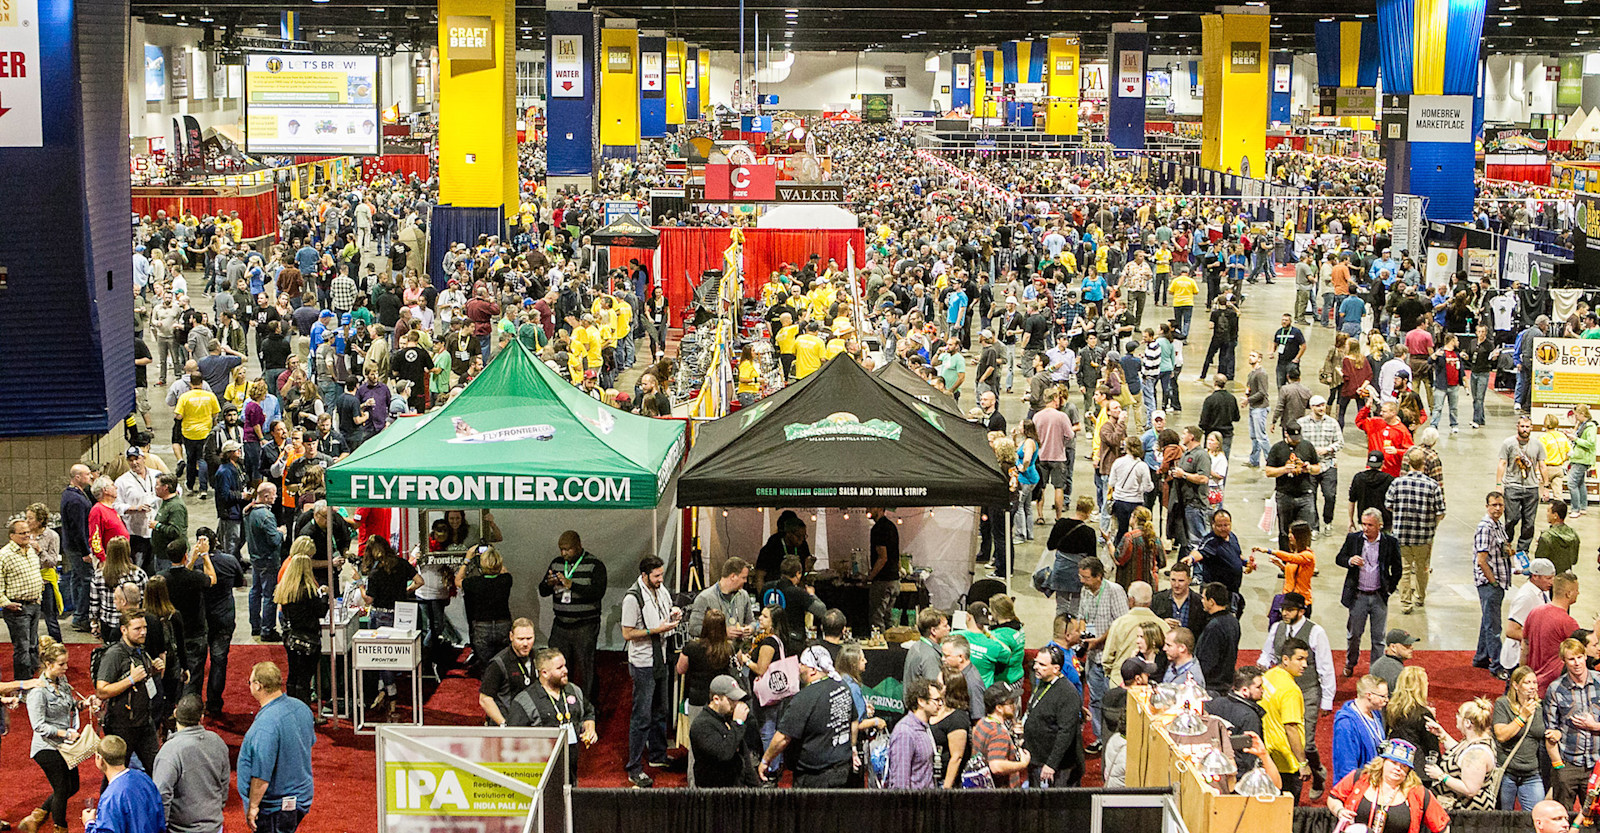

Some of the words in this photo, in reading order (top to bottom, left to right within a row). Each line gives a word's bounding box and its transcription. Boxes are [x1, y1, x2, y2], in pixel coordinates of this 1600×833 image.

[449, 27, 489, 38] CRAFT
[449, 37, 484, 48] BEER
[288, 60, 318, 70] LT'S
[321, 60, 357, 70] BRW!
[1231, 57, 1256, 65] BEER
[555, 70, 580, 79] WATER
[1121, 76, 1141, 84] WATER
[1421, 108, 1461, 119] HOMEBREW
[1415, 119, 1465, 130] MARKETPLACE
[730, 166, 751, 189] C
[779, 188, 839, 201] WALKER
[1411, 200, 1420, 257] DRINKTANKS
[1513, 261, 1529, 275] BRE
[350, 474, 631, 502] FLYFRONTIER.COM
[755, 487, 778, 496] GREEN
[779, 487, 812, 496] MOUNTAIN
[812, 487, 838, 496] GRINGO
[838, 487, 858, 496] SALSA
[859, 487, 874, 496] AND
[874, 487, 904, 496] TORTILLA
[904, 487, 928, 496] STRIPS
[358, 645, 382, 655] ENTER
[384, 645, 393, 655] TO
[395, 645, 411, 655] WIN
[394, 769, 470, 810] IPA
[473, 791, 506, 799] Evolution
[507, 791, 515, 799] of
[473, 802, 496, 810] INDIA
[497, 802, 516, 810] PALE
